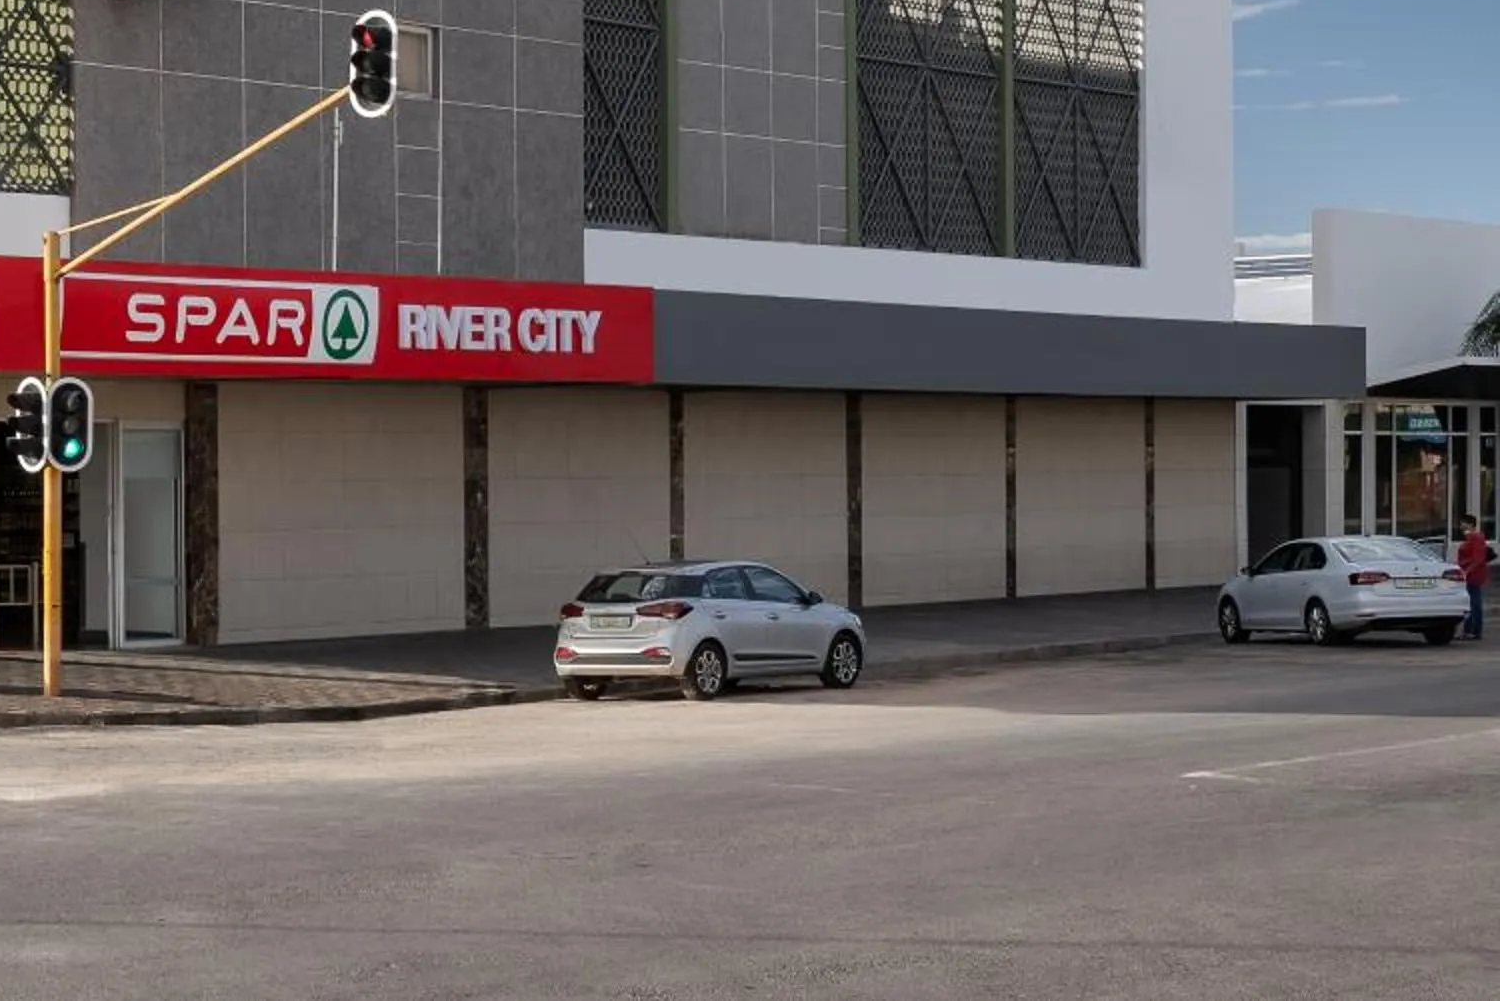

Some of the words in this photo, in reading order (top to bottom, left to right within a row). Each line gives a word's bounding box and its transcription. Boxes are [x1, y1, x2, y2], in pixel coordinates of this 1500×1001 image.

[124, 293, 307, 347] SPAR
[398, 303, 512, 352] RIVER
[516, 308, 602, 355] CITY
